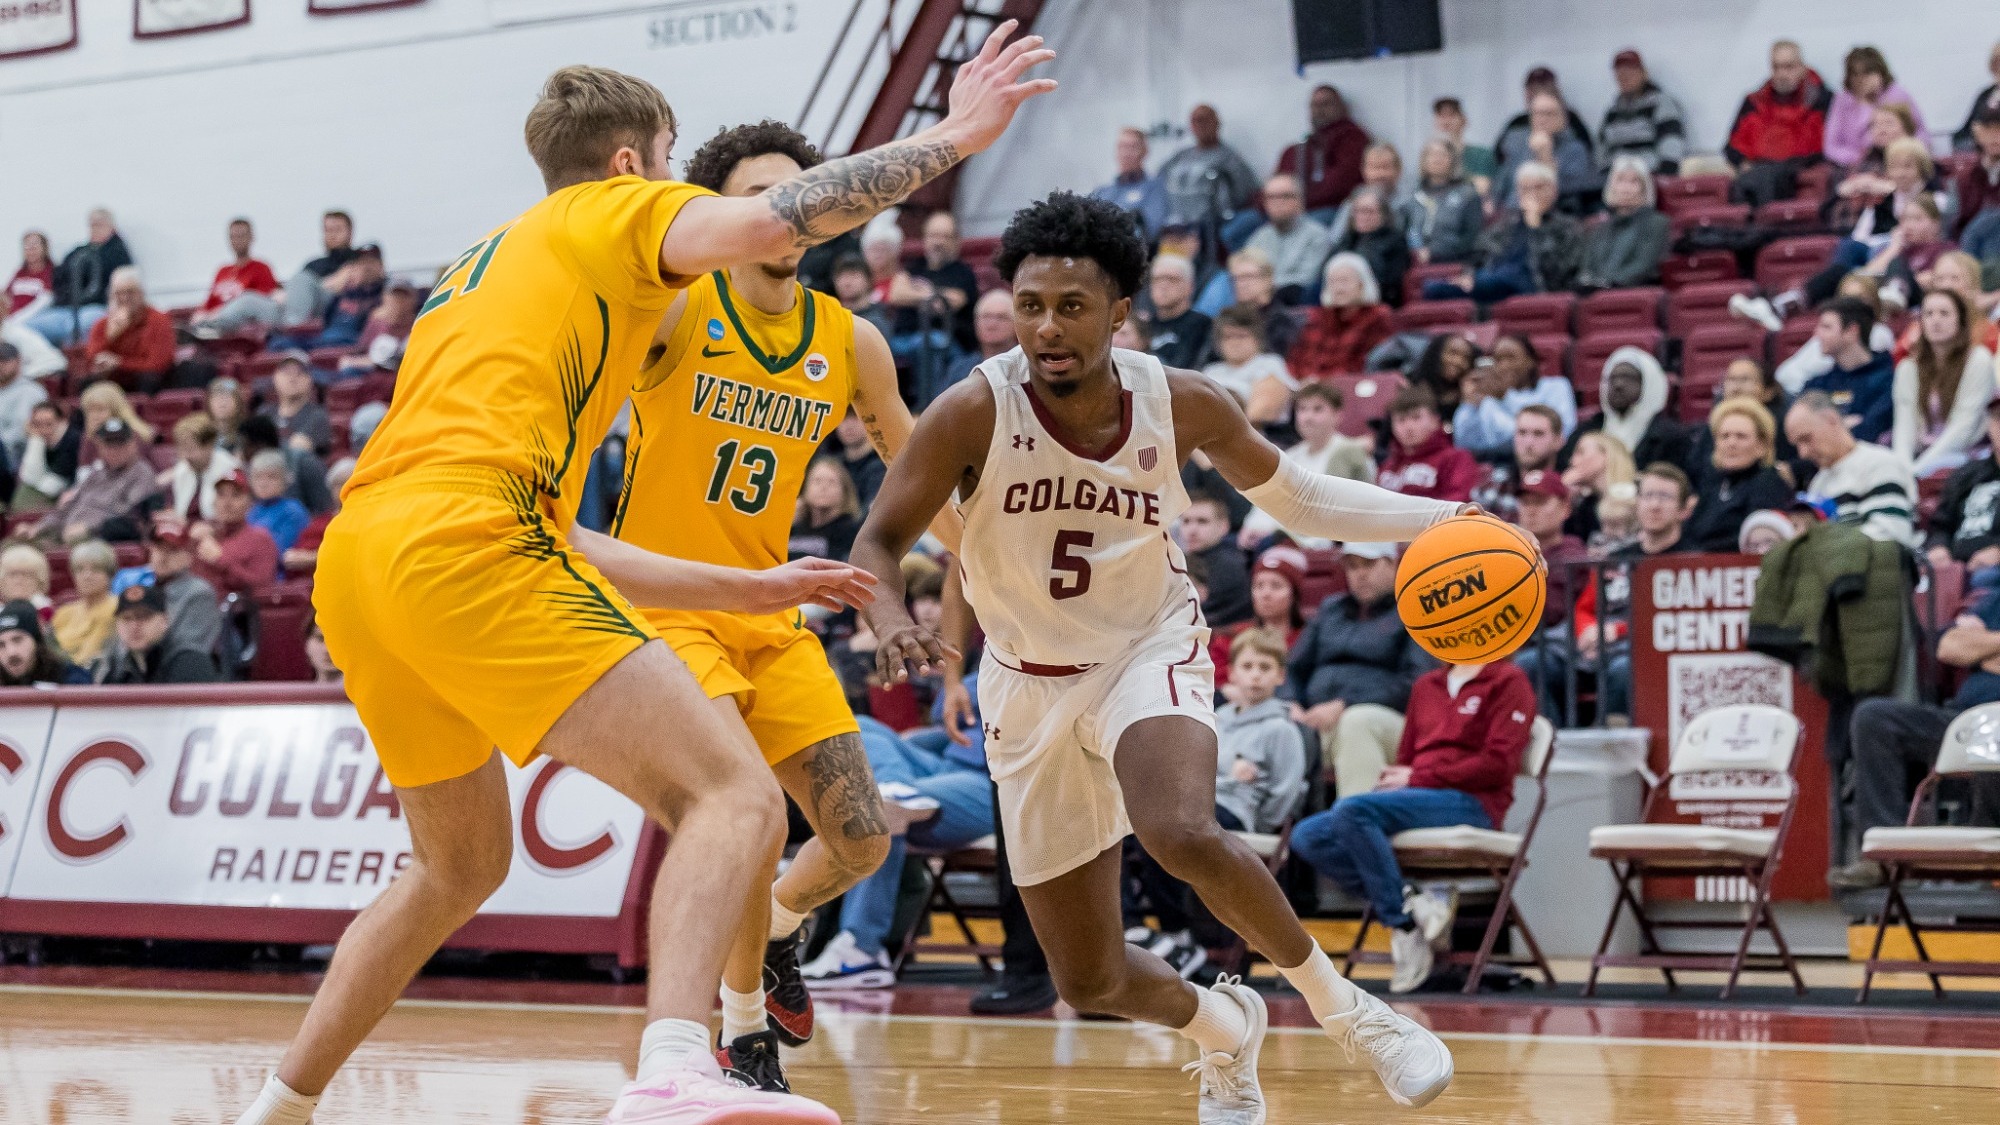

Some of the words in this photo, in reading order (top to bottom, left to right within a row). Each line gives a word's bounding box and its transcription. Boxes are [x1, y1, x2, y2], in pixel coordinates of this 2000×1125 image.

[648, 8, 775, 50] SECTION
[782, 4, 798, 34] 2
[416, 226, 512, 321] 21
[691, 372, 833, 443] VERMONT
[704, 438, 778, 517] 13
[1003, 476, 1160, 526] COLGATE
[1050, 529, 1094, 600] 5
[1418, 570, 1487, 616] NCAA
[1425, 603, 1522, 649] Wilson
[1653, 611, 1750, 652] CENT
[46, 738, 148, 860] C
